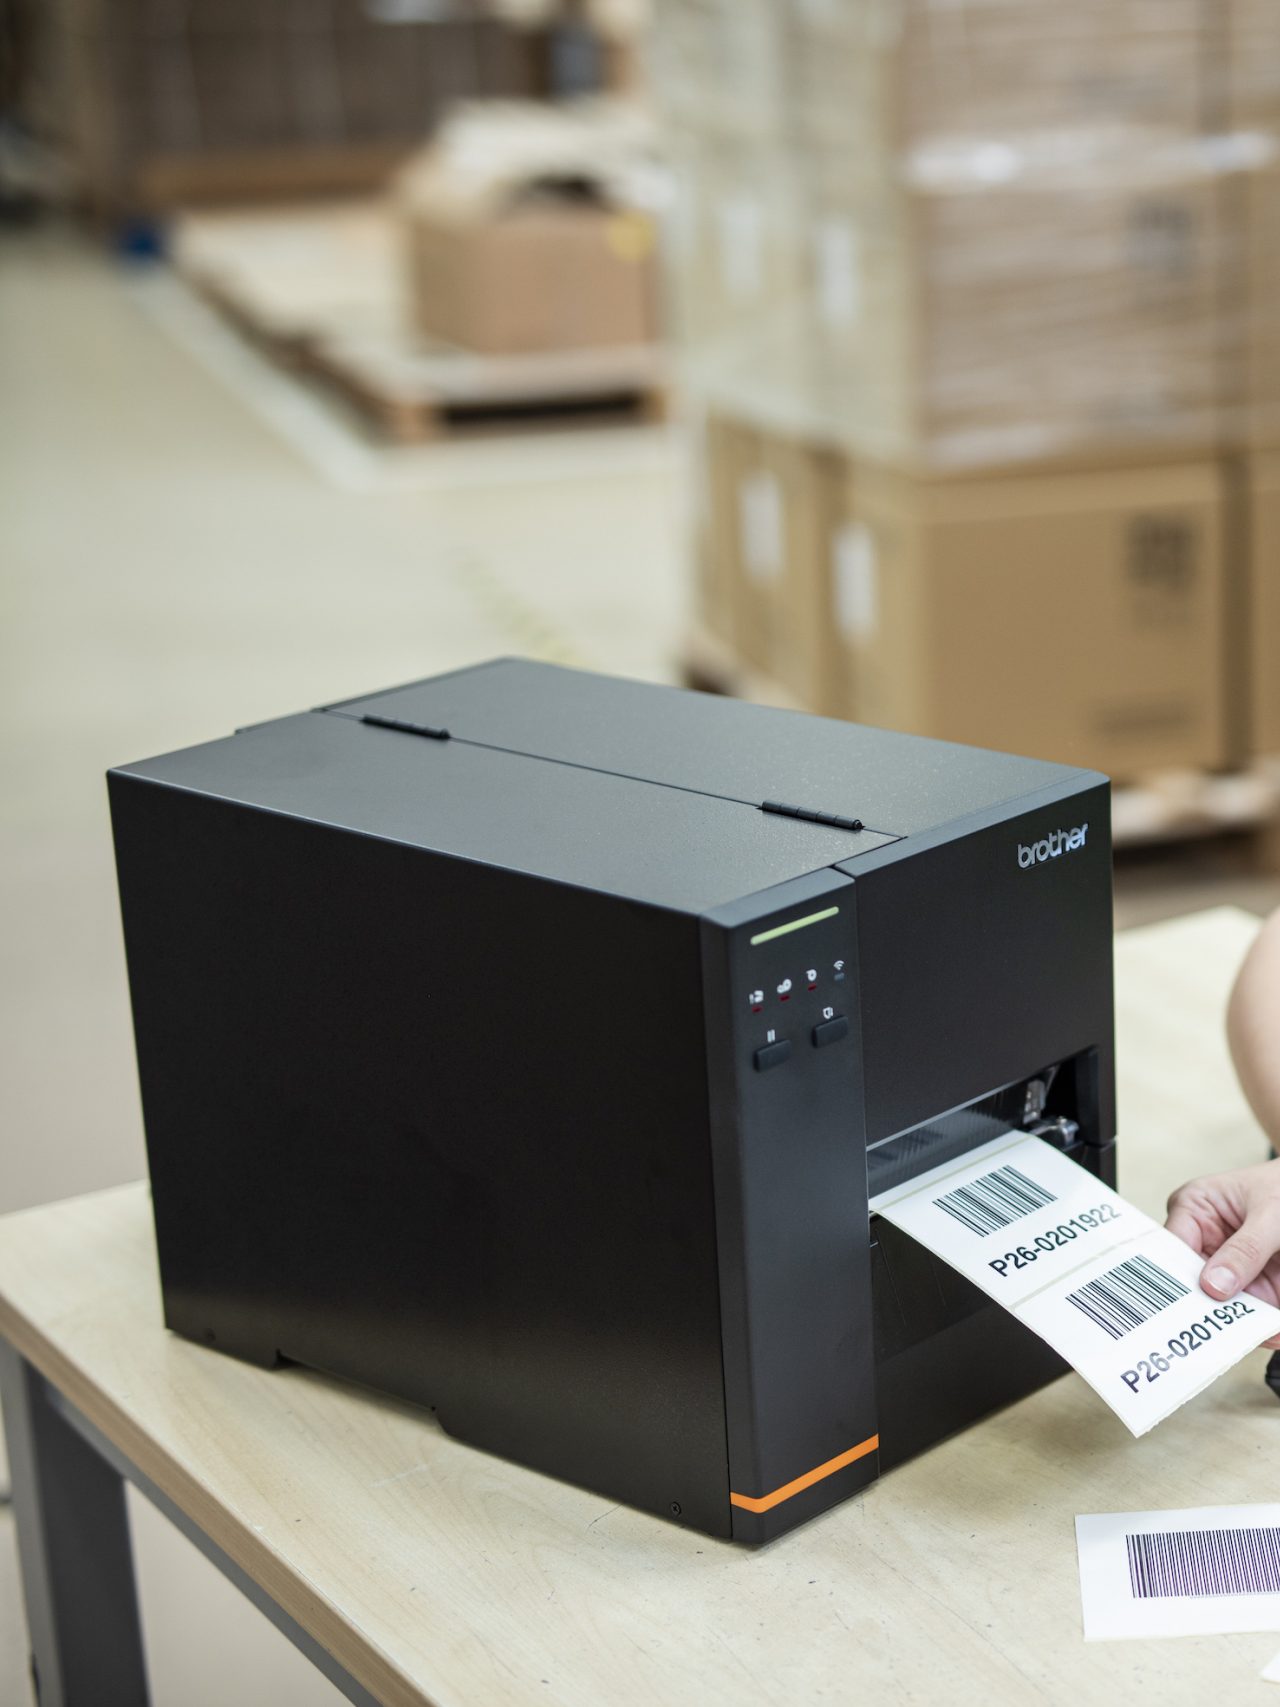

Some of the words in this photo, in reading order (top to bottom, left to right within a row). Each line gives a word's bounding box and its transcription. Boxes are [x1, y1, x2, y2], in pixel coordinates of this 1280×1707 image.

[1017, 823, 1089, 869] brother
[988, 1202, 1122, 1278] P26-0201922
[1119, 1300, 1256, 1394] P26-0201922
